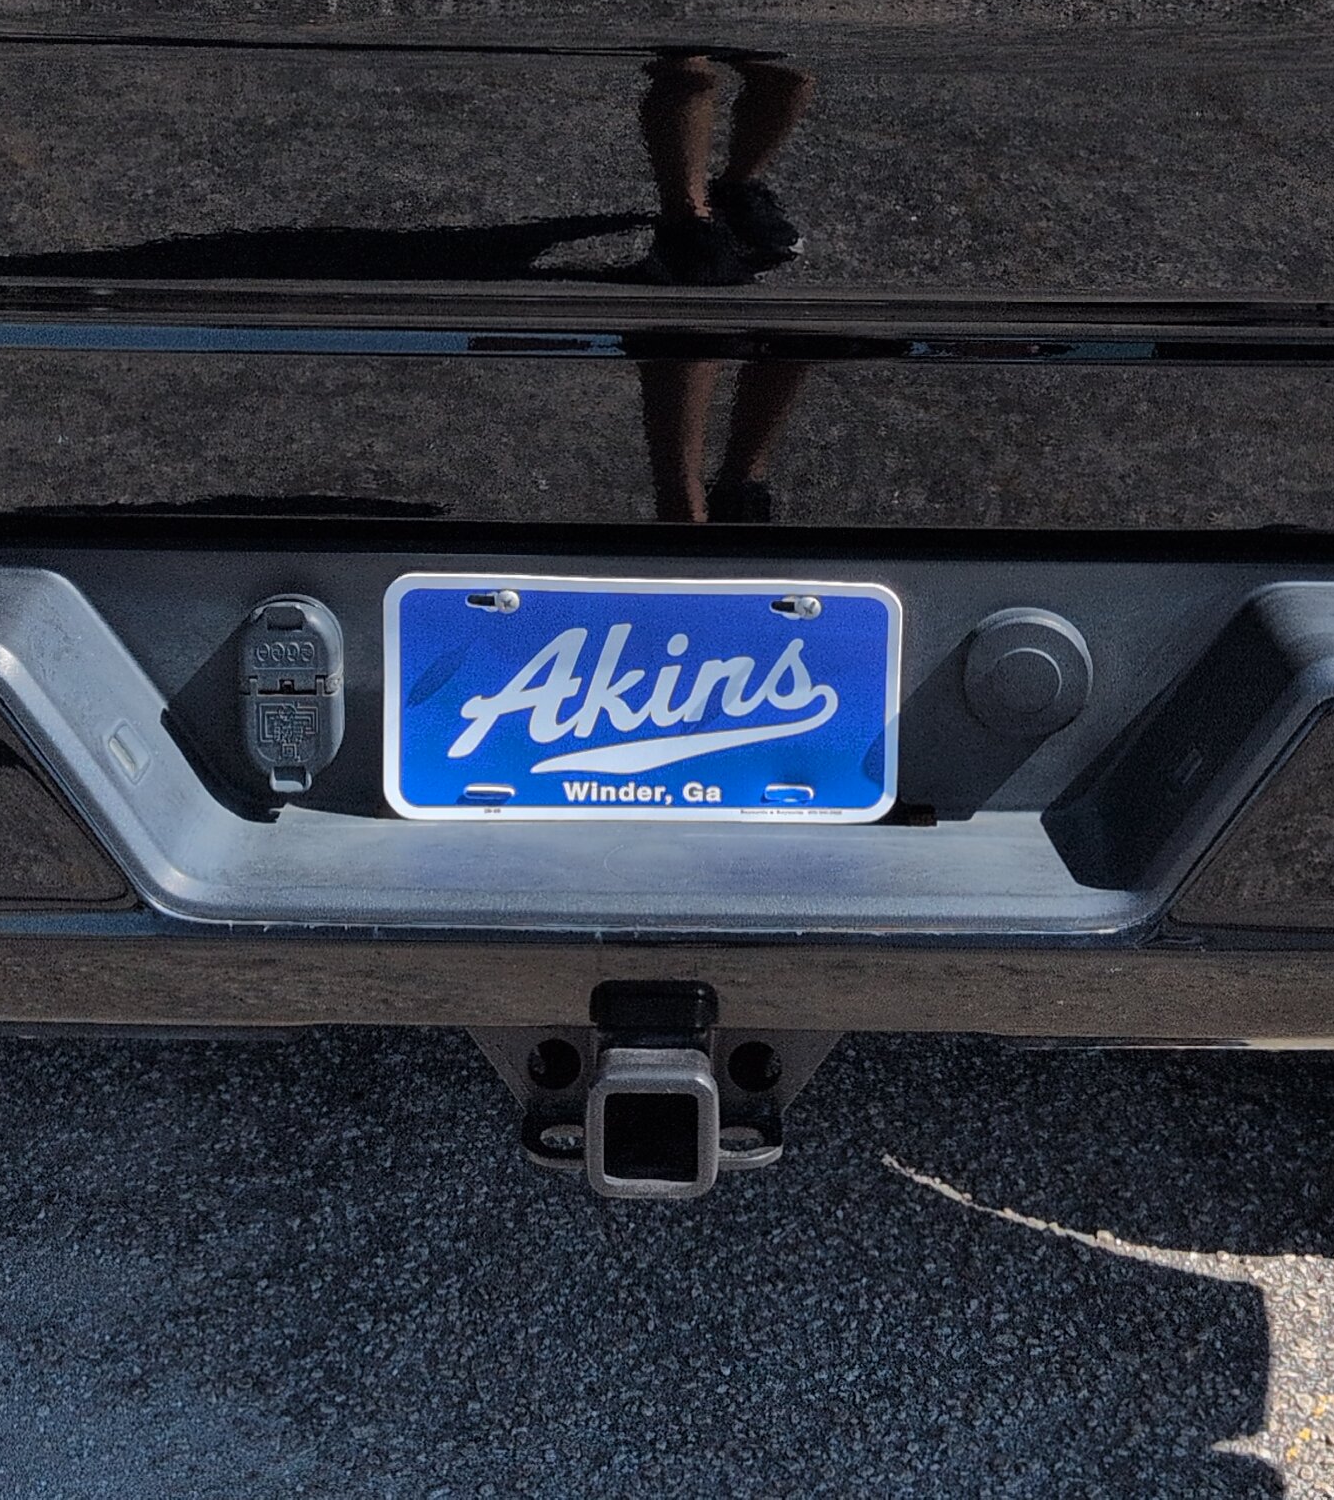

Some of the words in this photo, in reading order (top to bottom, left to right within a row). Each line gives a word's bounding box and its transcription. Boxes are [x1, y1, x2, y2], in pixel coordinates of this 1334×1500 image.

[447, 622, 839, 774] Akins
[563, 781, 673, 806] Winder,
[682, 781, 722, 803] Ga
